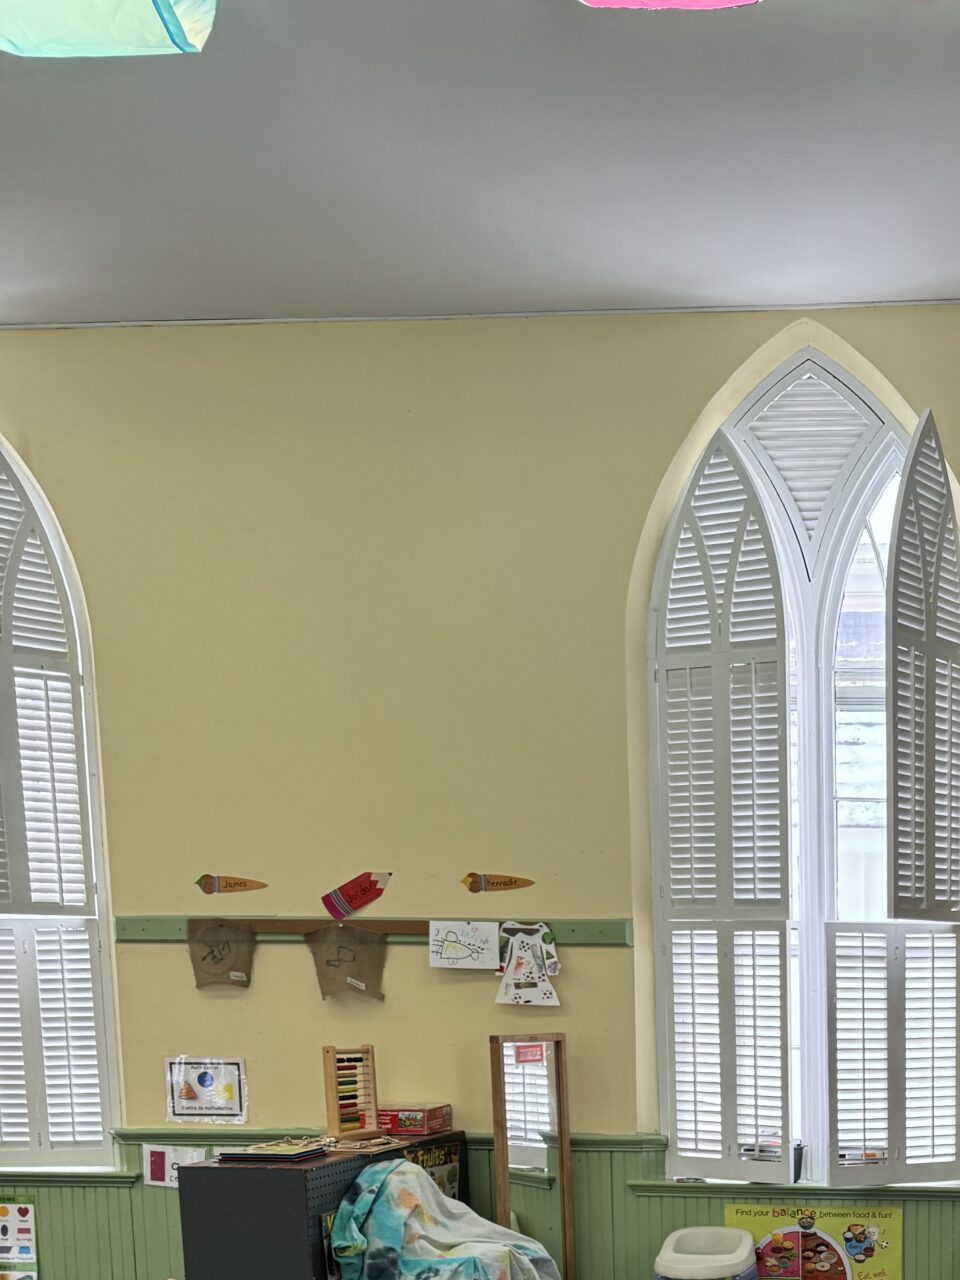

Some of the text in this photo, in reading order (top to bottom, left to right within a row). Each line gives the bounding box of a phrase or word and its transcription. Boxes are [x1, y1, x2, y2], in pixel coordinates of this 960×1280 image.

[223, 881, 248, 889] James
[346, 880, 379, 904] Jordan
[735, 1208, 752, 1216] Find
[753, 1209, 770, 1217] your
[771, 1207, 817, 1219] balance
[819, 1210, 851, 1218] between
[852, 1211, 870, 1219] food
[878, 1211, 893, 1219] fun!
[857, 1272, 872, 1280] Eat
